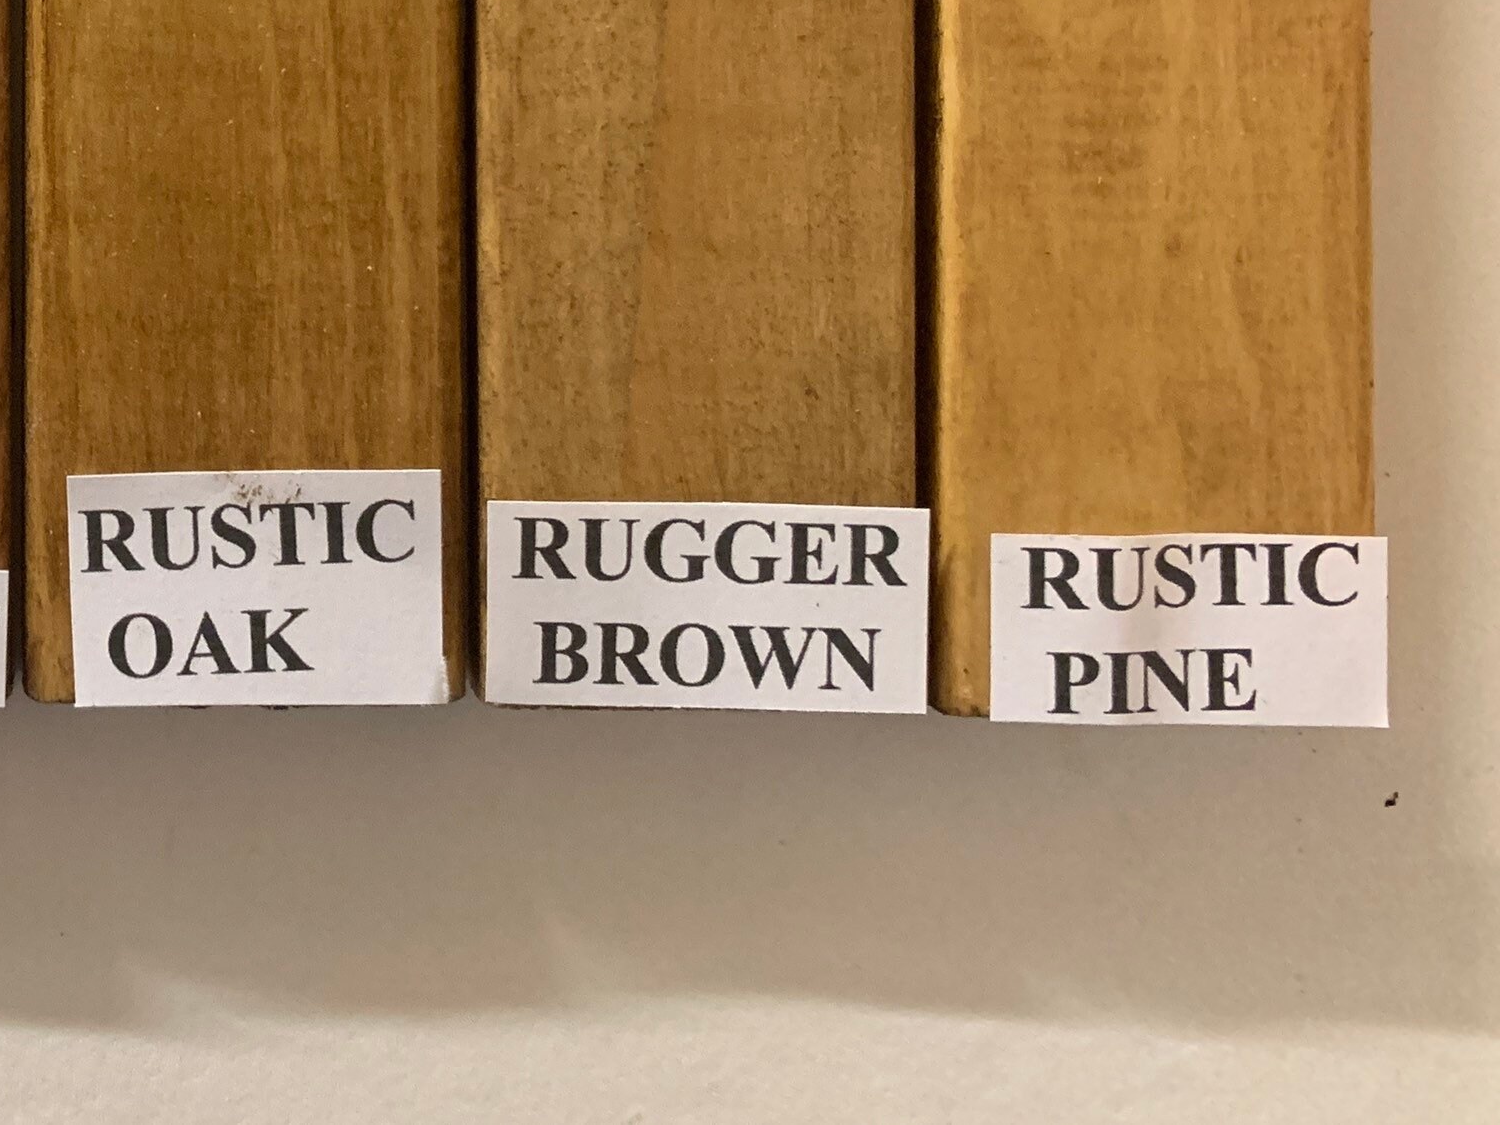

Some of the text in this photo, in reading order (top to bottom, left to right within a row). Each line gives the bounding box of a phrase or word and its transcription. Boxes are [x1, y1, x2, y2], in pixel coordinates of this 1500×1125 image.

[79, 499, 415, 573] RUSTIC
[511, 517, 908, 587] RUGGER
[1021, 542, 1359, 612] RUSTIC
[108, 608, 315, 679] OAK
[532, 621, 882, 692] BROWN
[1046, 648, 1257, 715] PINE
